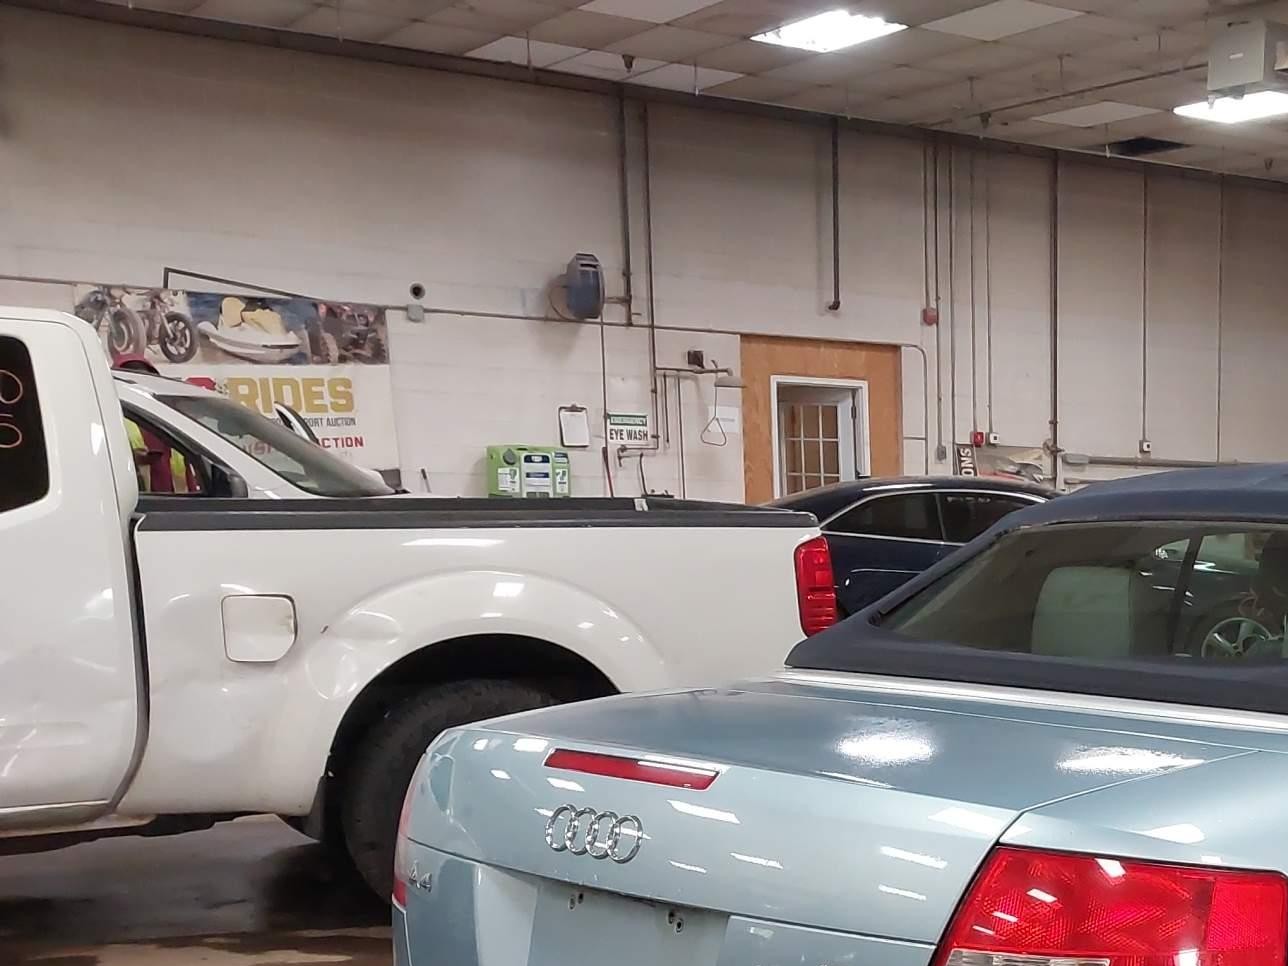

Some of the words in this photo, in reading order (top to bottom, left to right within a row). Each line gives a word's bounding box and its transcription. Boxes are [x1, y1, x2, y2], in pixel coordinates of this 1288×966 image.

[226, 377, 355, 413] RIDES
[326, 416, 356, 427] AUCTION
[609, 428, 624, 440] EYE
[626, 429, 649, 441] WASH
[960, 447, 974, 477] ONS
